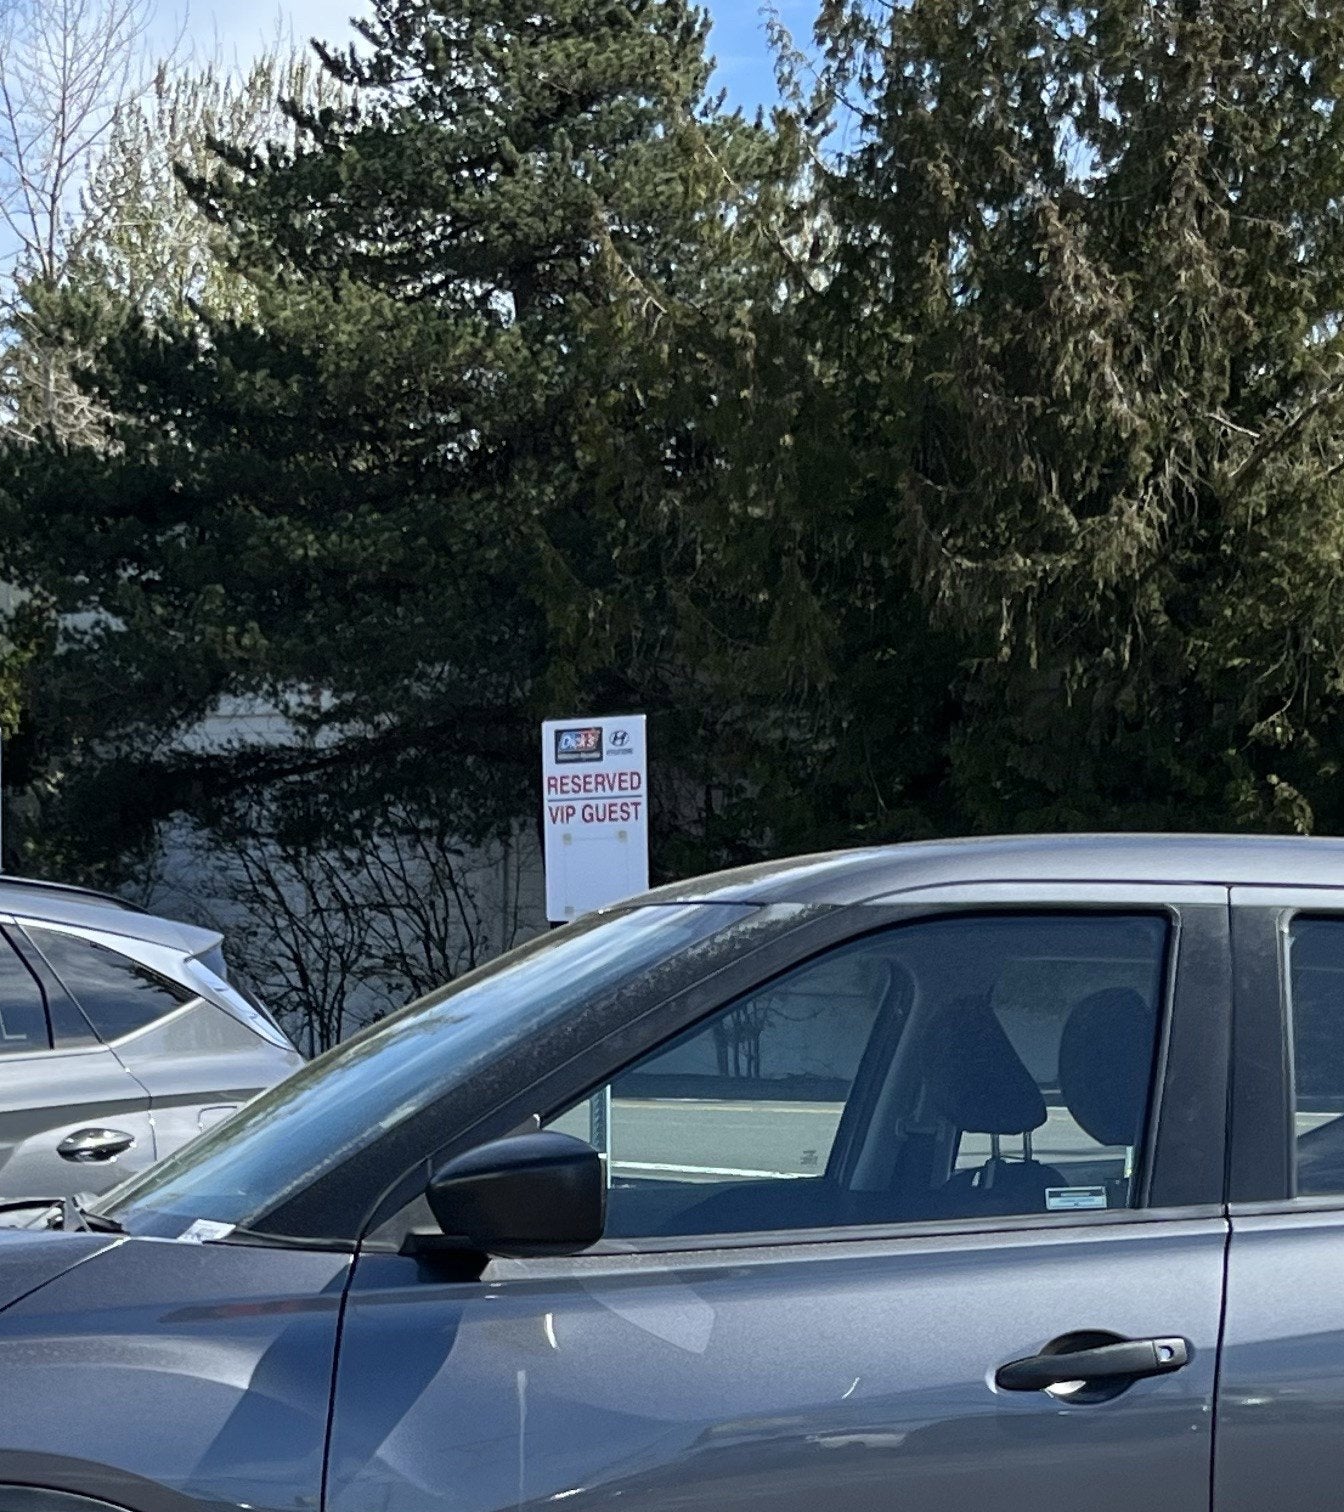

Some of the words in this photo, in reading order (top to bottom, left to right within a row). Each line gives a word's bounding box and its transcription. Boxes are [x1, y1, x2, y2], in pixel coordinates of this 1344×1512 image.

[547, 771, 642, 795] RESERVED
[548, 805, 576, 825] VIP
[582, 802, 642, 824] GUEST
